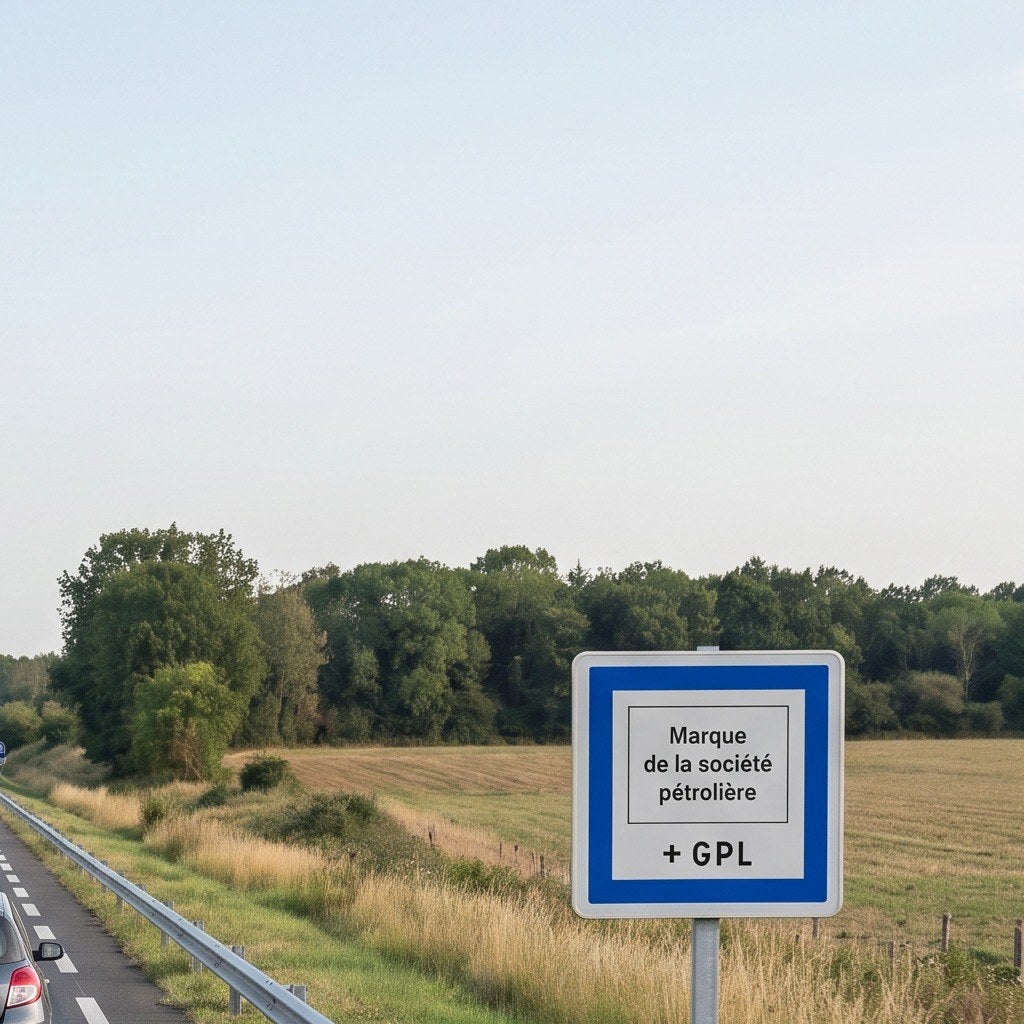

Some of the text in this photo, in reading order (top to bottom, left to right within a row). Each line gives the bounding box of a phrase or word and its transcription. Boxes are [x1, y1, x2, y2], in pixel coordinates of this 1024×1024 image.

[669, 726, 747, 749] Marque
[643, 753, 773, 773] de la société
[659, 782, 757, 806] pétrolière
[662, 841, 753, 867] + GPL
